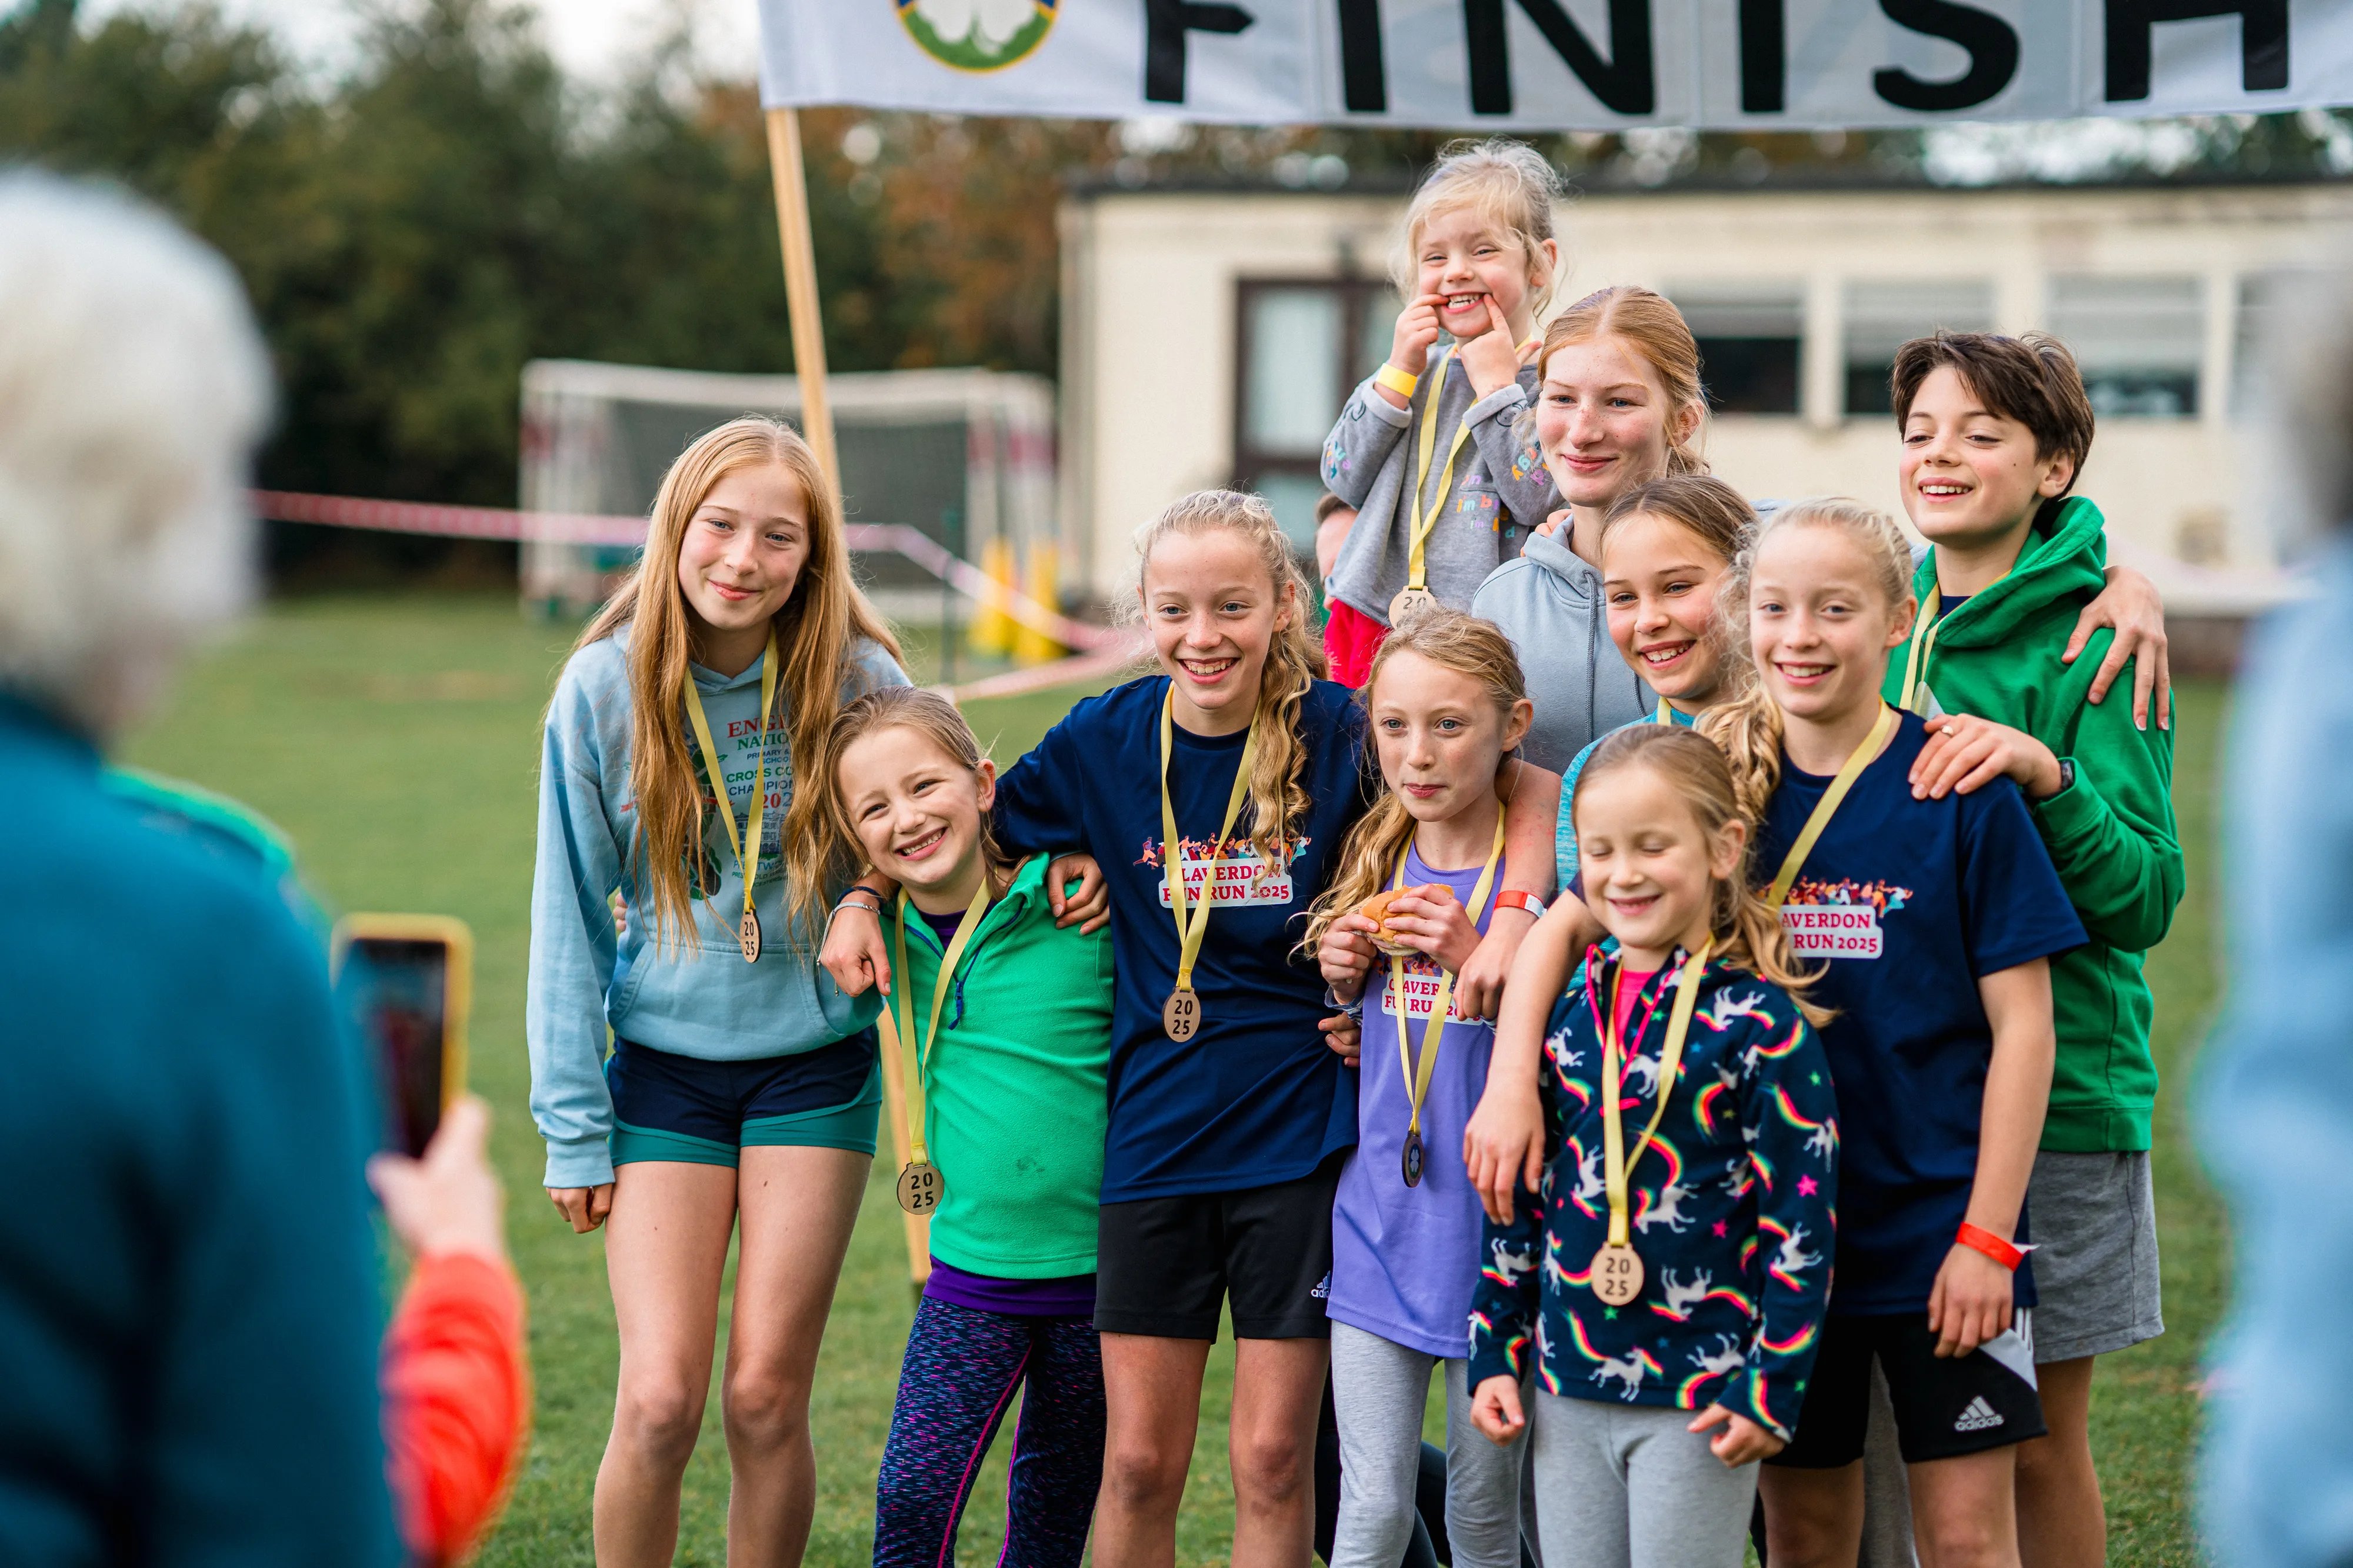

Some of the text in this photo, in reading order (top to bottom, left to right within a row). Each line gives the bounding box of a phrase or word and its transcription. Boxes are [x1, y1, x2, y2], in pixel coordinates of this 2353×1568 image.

[737, 733, 789, 750] NATIO
[728, 780, 793, 796] CHAPIO
[1180, 863, 1281, 882] LAERDON
[1163, 887, 1201, 901] FN
[1211, 885, 1245, 900] RUN
[744, 922, 754, 936] 20
[1781, 913, 1870, 928] AVERDON
[745, 941, 755, 956] 25
[1794, 934, 1877, 952] RUN 2025
[1174, 999, 1193, 1016] 20
[1172, 1019, 1191, 1035] 25
[911, 1172, 934, 1190] 20
[912, 1191, 934, 1209] 25
[1605, 1257, 1630, 1274] 20
[1605, 1279, 1628, 1296] 25
